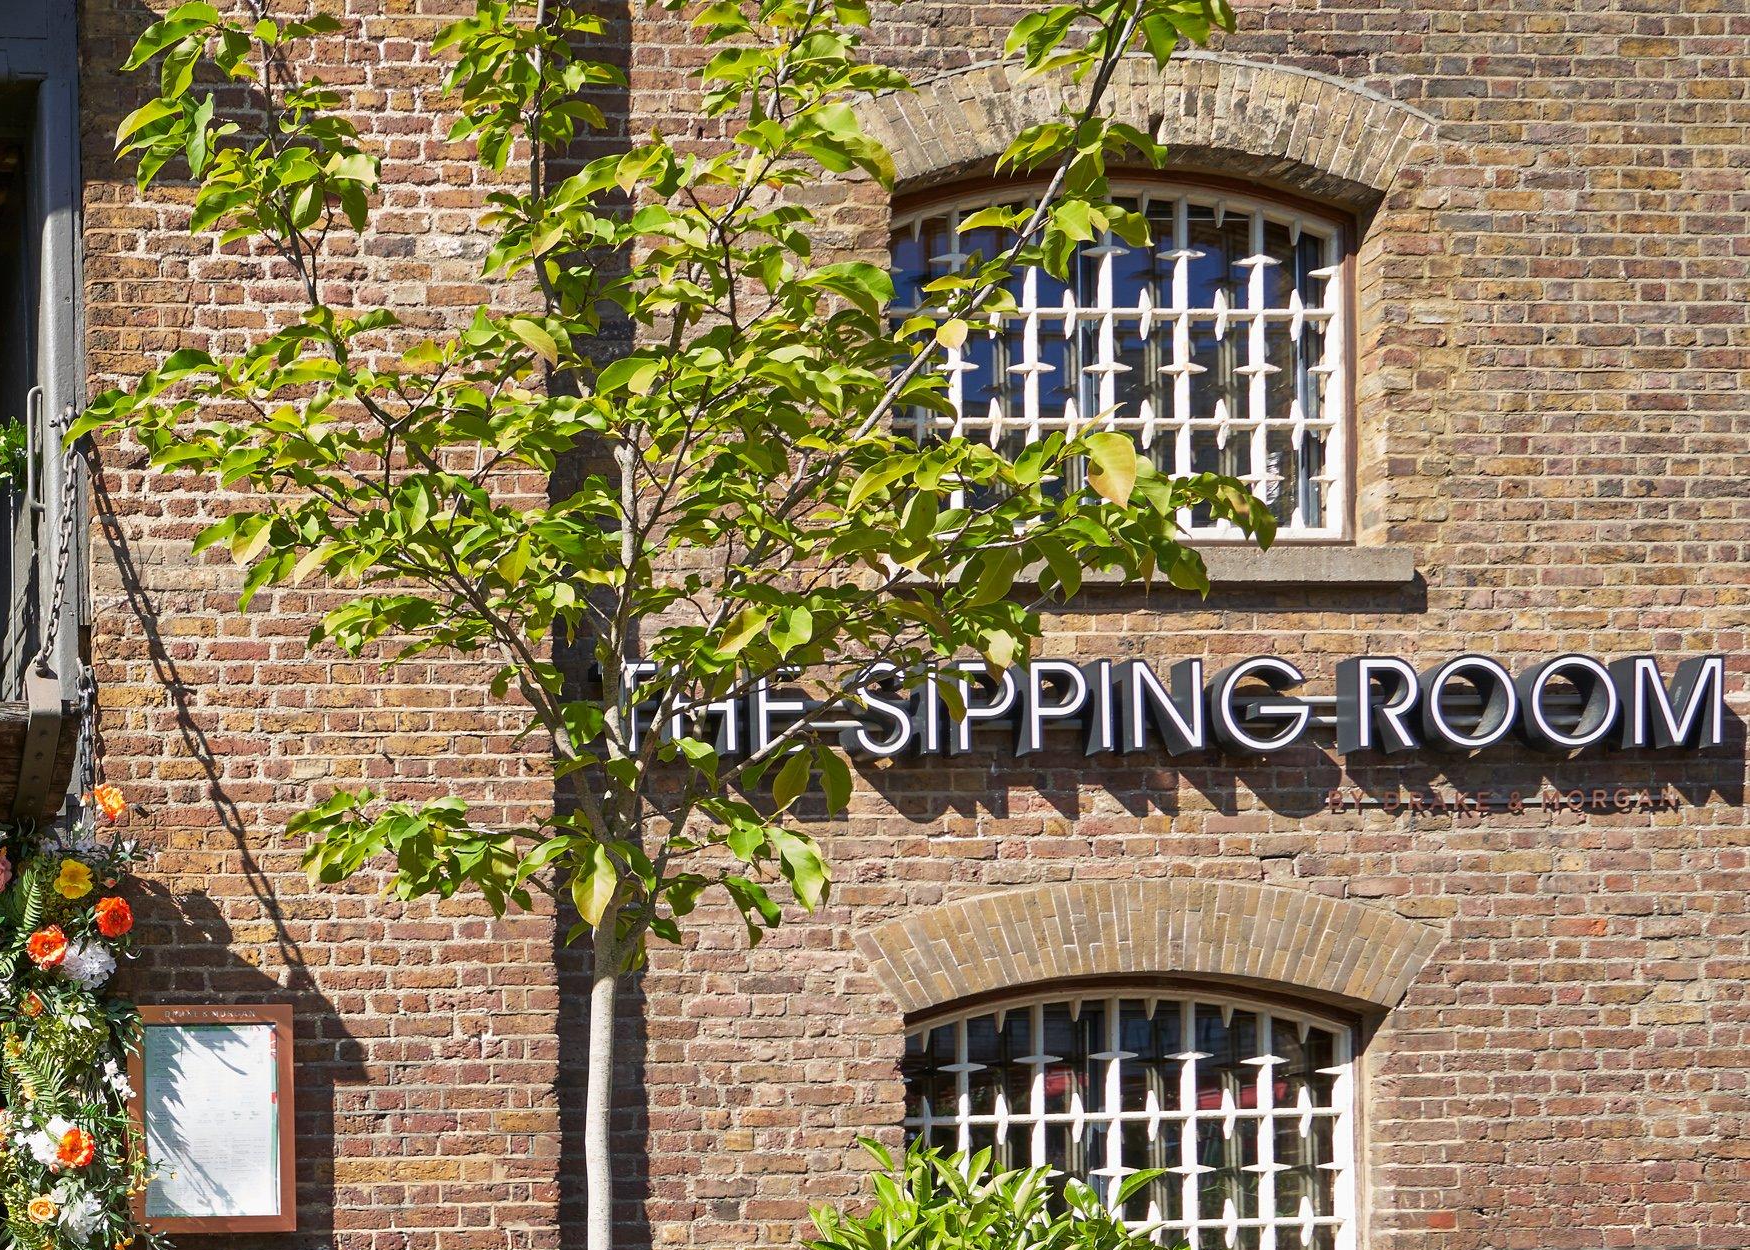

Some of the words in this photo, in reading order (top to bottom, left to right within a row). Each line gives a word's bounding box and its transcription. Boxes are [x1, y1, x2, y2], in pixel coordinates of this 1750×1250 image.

[853, 656, 1310, 755] SIPPING
[1356, 655, 1724, 750] ROOM
[1328, 789, 1364, 811] BY
[1383, 790, 1490, 812] DRAKE
[1506, 790, 1525, 811] &
[1541, 787, 1679, 811] MORGAN
